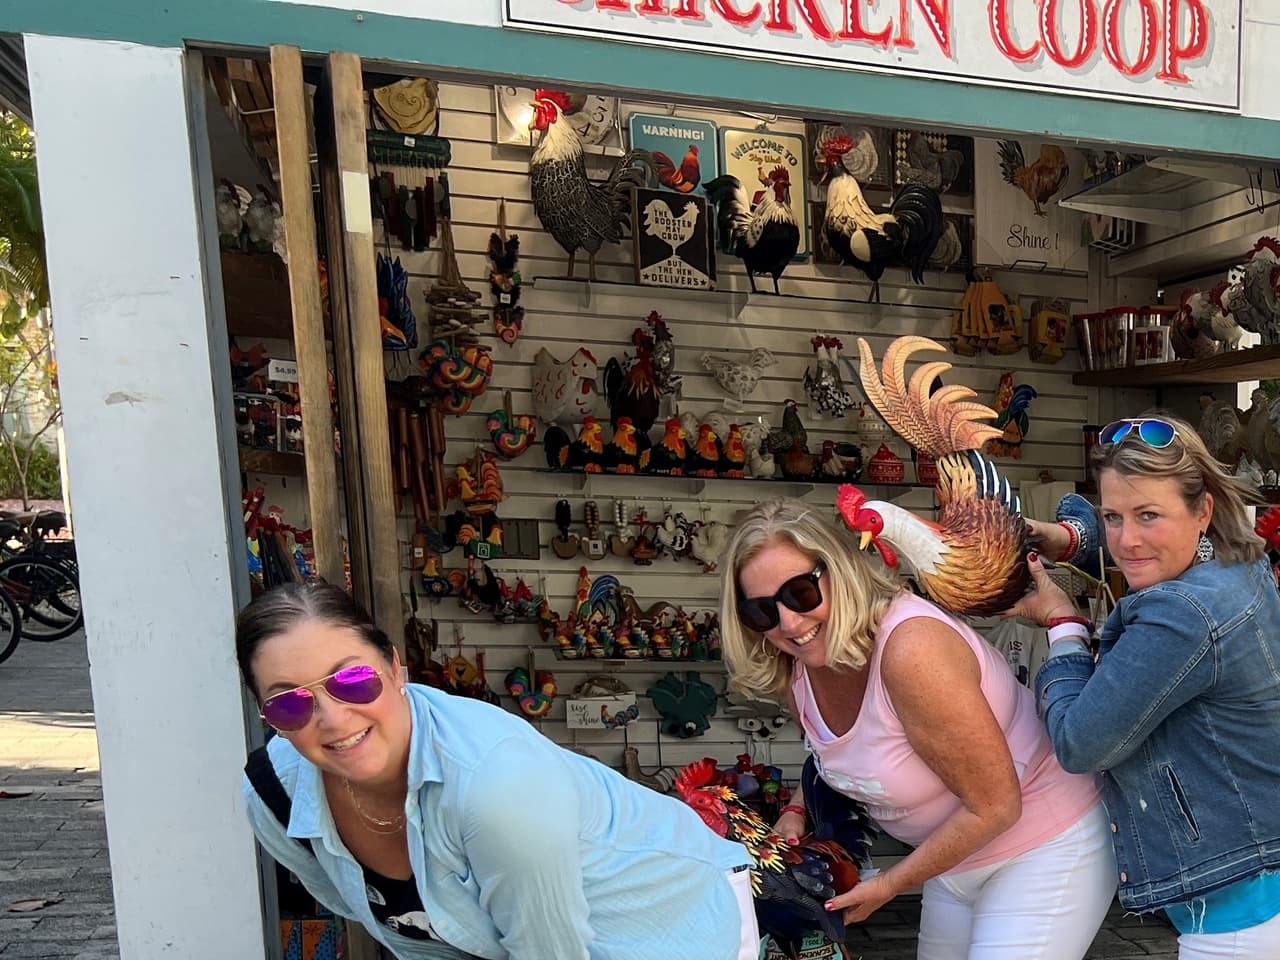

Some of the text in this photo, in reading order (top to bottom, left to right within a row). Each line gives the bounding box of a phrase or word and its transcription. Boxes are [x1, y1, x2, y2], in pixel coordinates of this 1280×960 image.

[986, 0, 1210, 83] COOP
[642, 124, 705, 141] WARNING!
[730, 138, 798, 167] WELCOME TO
[654, 209, 668, 218] THE
[654, 217, 692, 228] ROOSTER
[661, 232, 686, 241] CROW
[658, 266, 692, 276] THE HEN
[651, 273, 699, 286] DELIVERS
